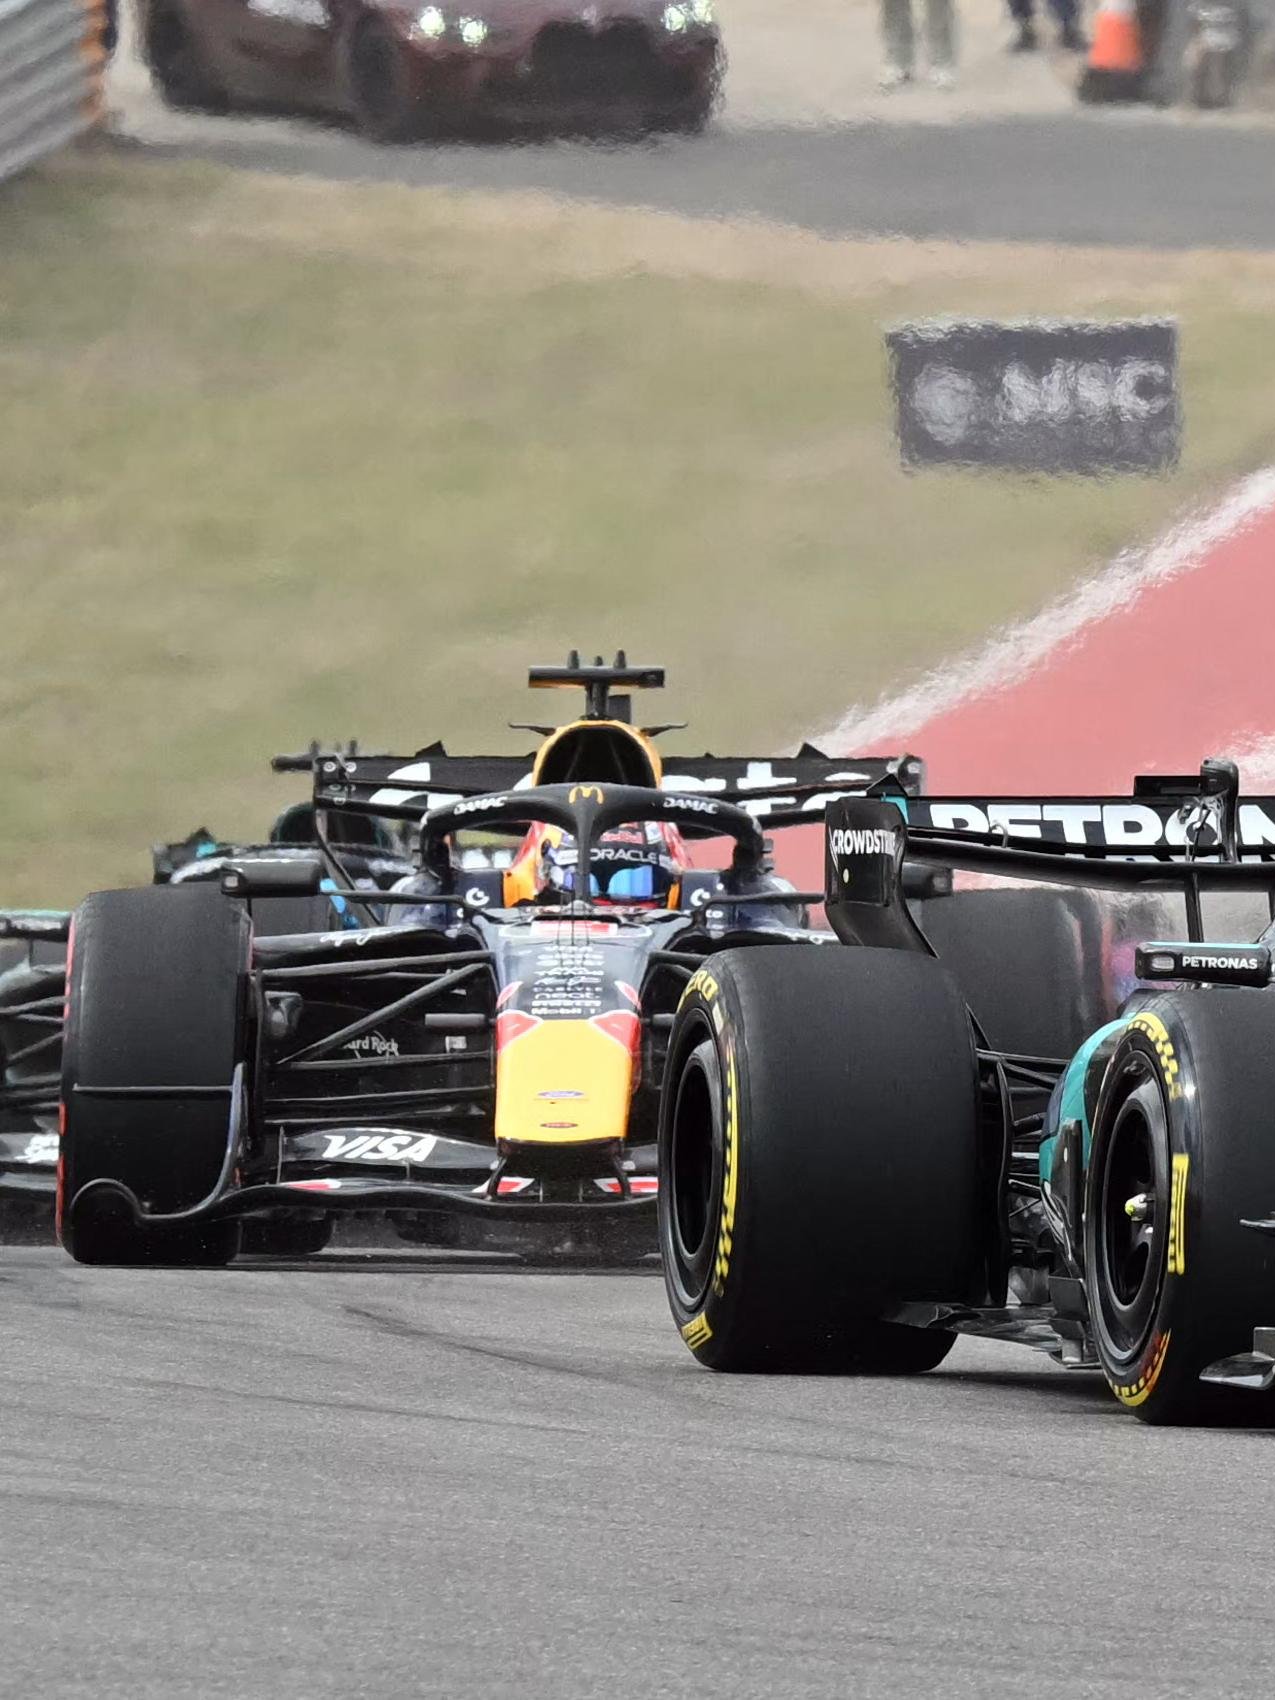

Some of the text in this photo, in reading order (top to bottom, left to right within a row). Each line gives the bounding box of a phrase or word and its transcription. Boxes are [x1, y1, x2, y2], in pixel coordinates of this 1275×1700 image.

[663, 798, 719, 815] DAMAC
[1182, 956, 1258, 970] PETRONAS
[344, 1035, 369, 1049] ard
[322, 1135, 438, 1162] VISA
